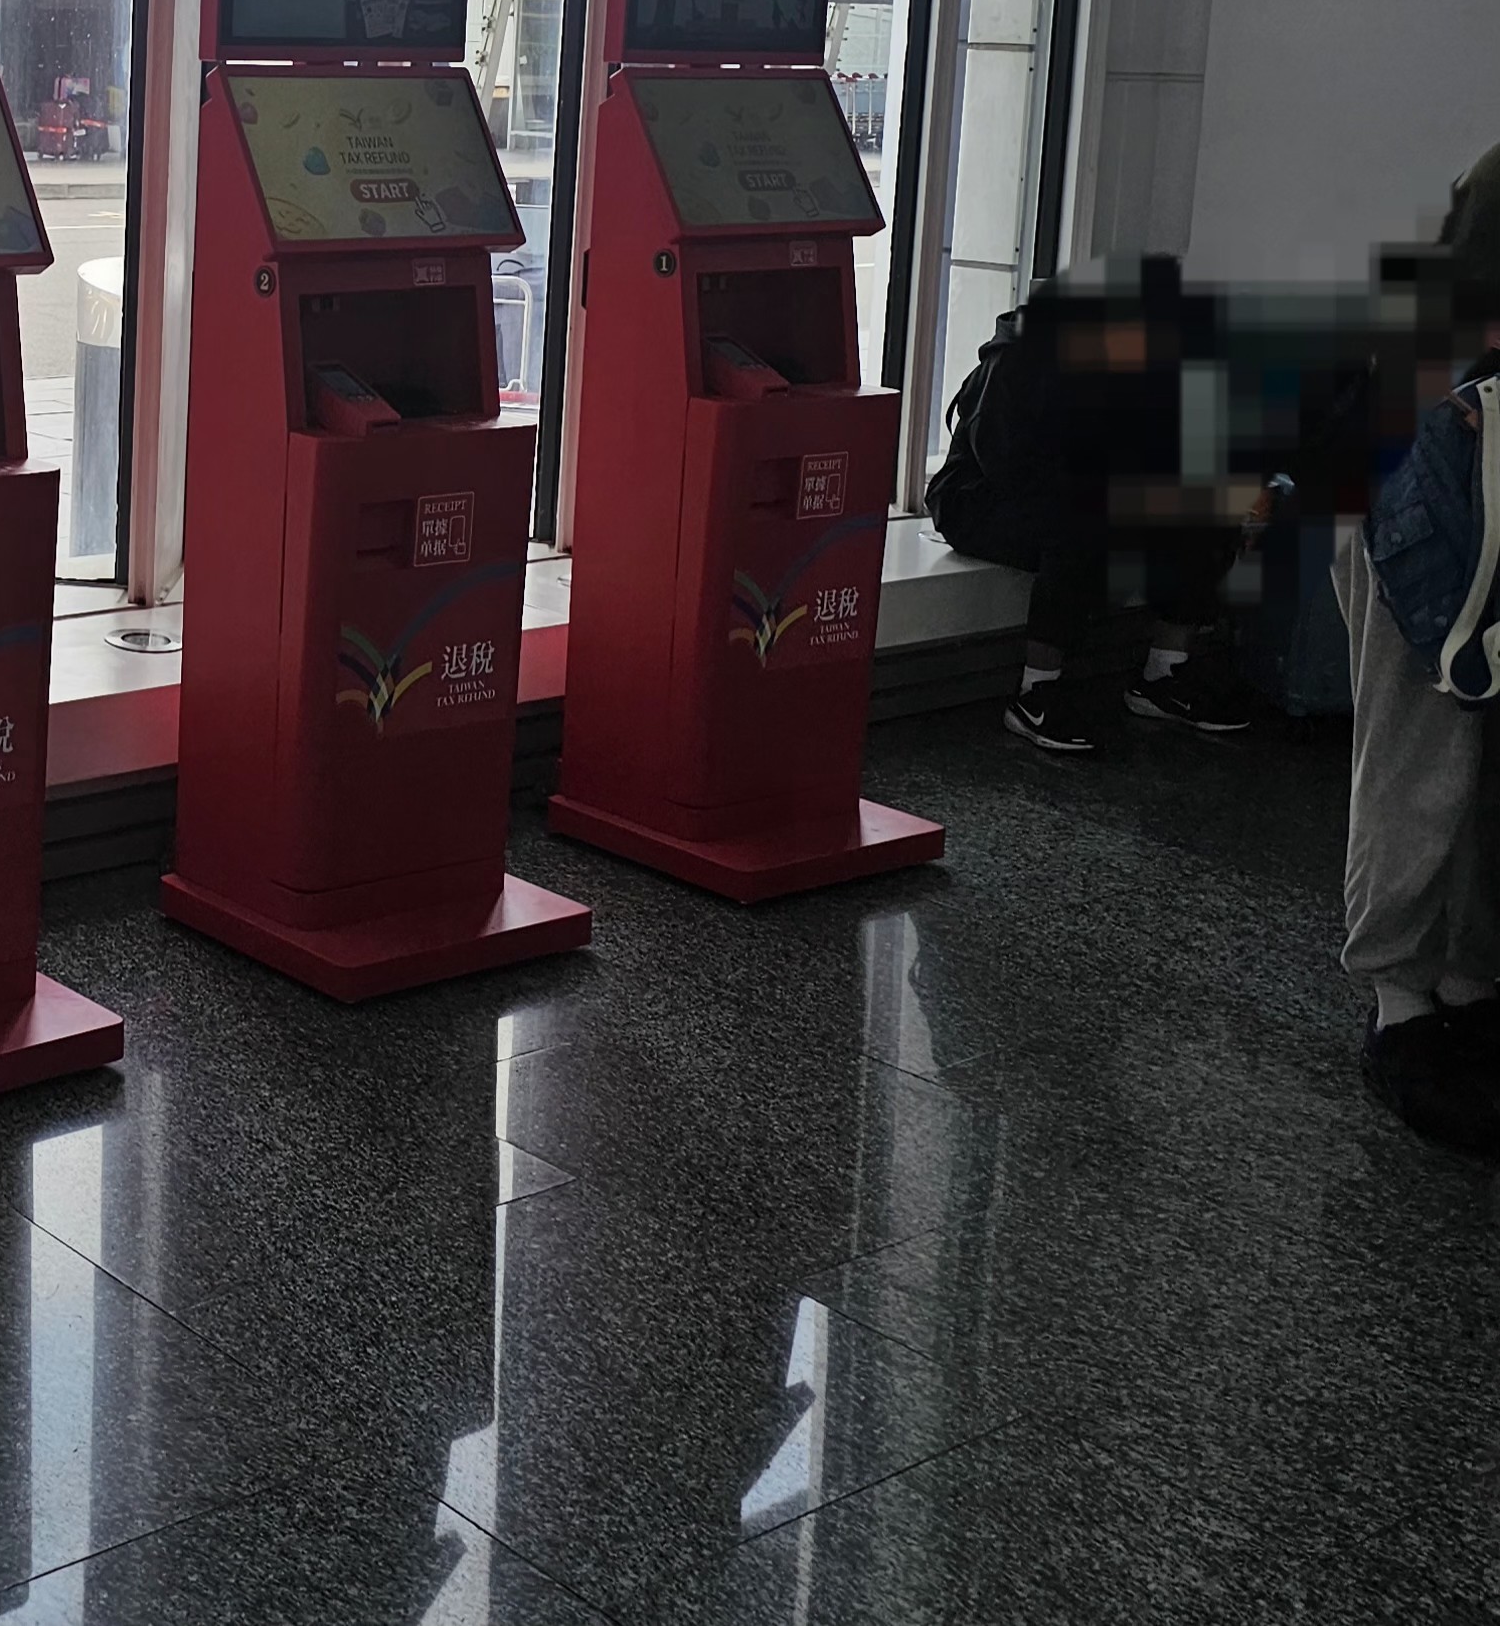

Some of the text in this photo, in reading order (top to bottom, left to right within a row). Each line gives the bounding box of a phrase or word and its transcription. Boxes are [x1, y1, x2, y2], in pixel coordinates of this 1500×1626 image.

[346, 136, 394, 150] TAIWAN
[339, 151, 411, 165] TAX REFUND
[359, 181, 409, 199] START
[745, 173, 787, 189] START
[659, 254, 669, 272] 1
[260, 272, 269, 291] 2
[814, 586, 860, 622] 退稅
[441, 639, 496, 681] 退稅
